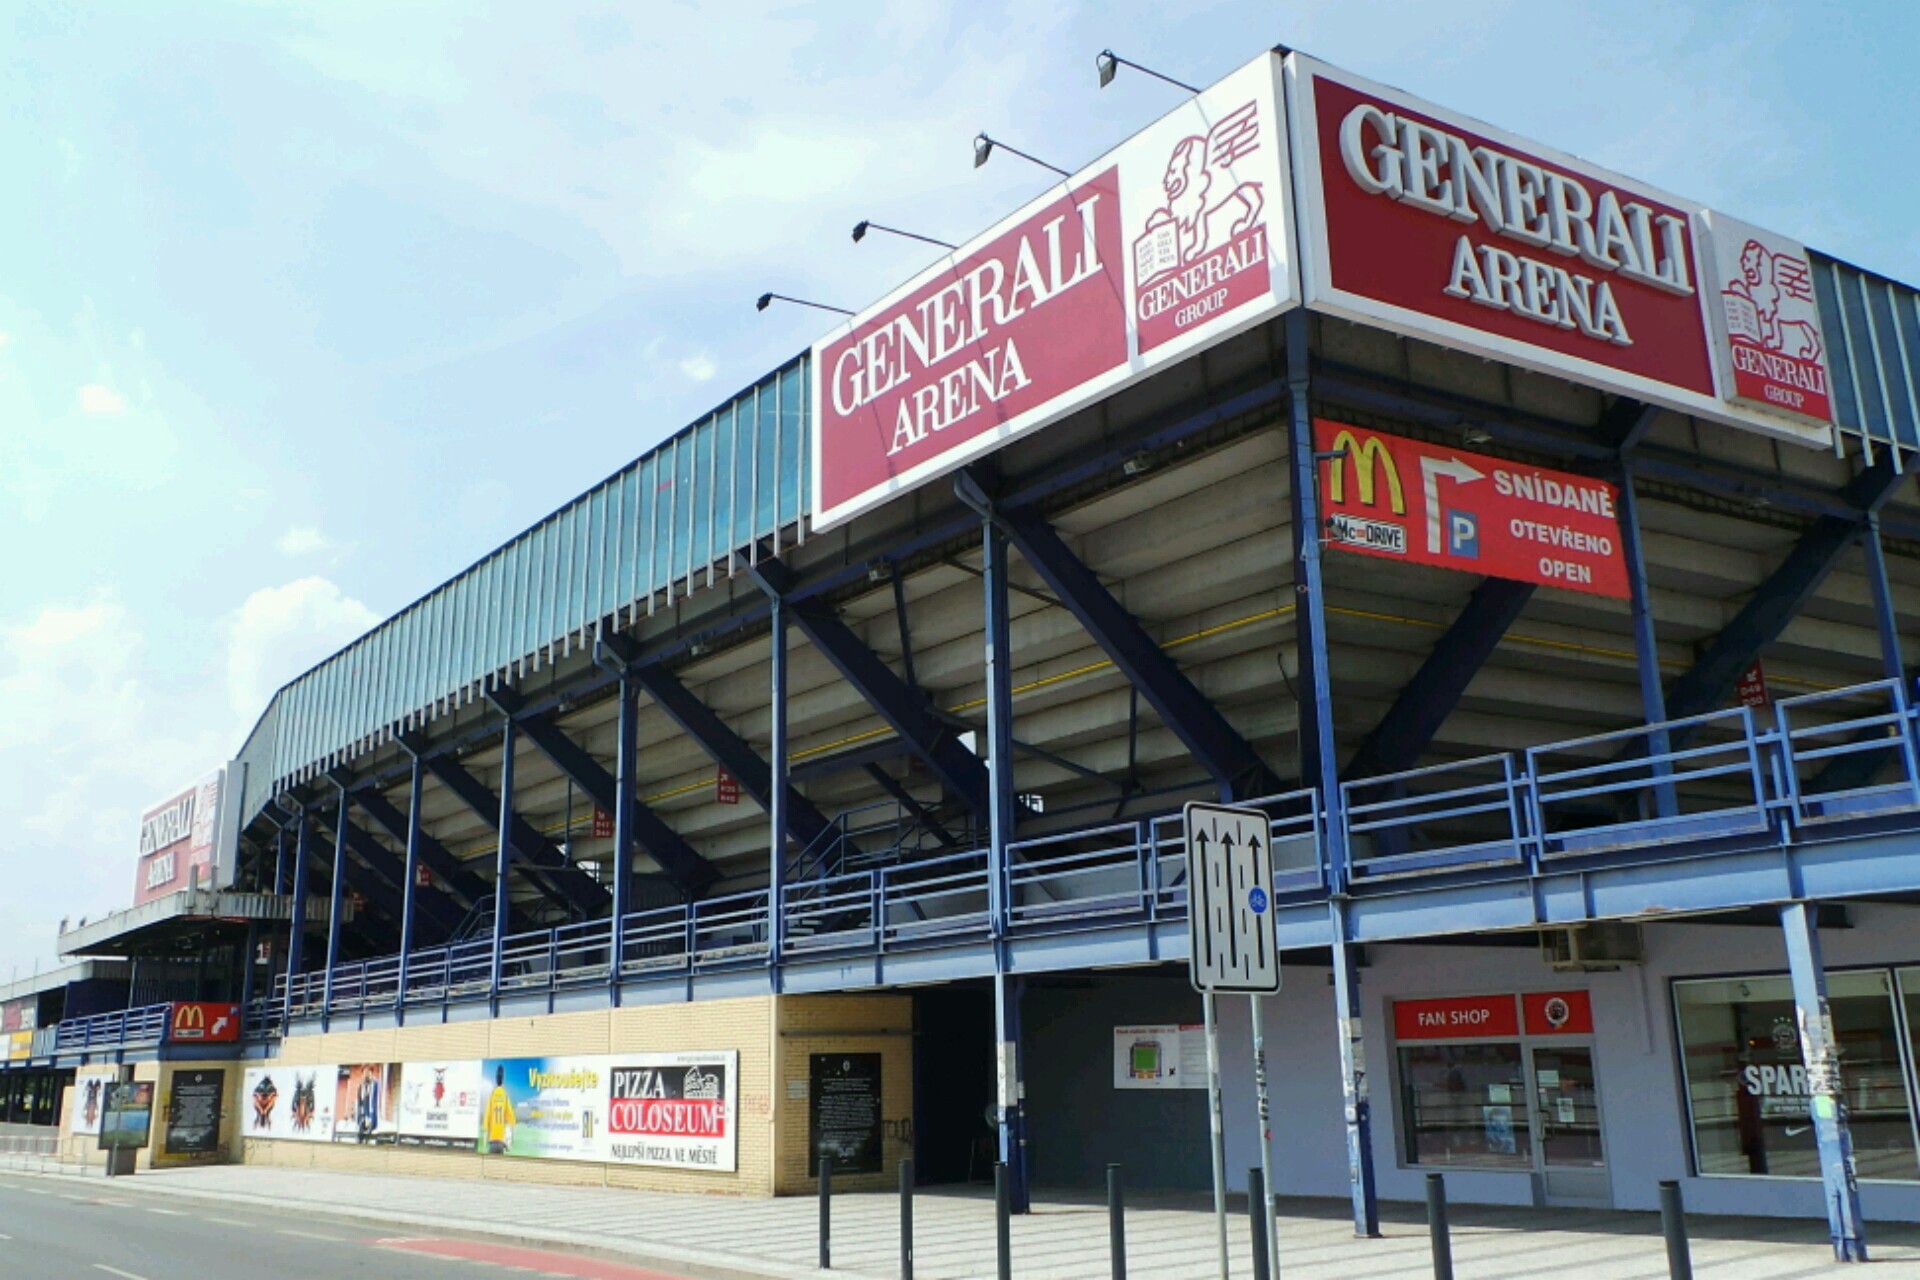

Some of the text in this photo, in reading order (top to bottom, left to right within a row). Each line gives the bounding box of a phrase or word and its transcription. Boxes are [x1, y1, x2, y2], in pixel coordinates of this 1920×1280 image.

[1339, 103, 1695, 296] GENERALI
[1138, 231, 1265, 321] GENERALI
[1443, 235, 1634, 346] ARENA
[832, 194, 1103, 417] GENERALI
[1175, 288, 1228, 328] GROUP
[1731, 344, 1827, 396] GENERALI
[887, 337, 1032, 456] ARENA
[1764, 384, 1804, 408] GROUP
[1492, 469, 1615, 518] SNÍDANĚ
[1510, 518, 1612, 556] OTEVŘENO
[1539, 557, 1592, 584] OPEN
[1417, 1008, 1490, 1026] FAN SHOP
[614, 1071, 666, 1099] PIZZA
[1745, 1064, 1810, 1095] SPAR
[611, 1103, 719, 1134] COLOSEUM
